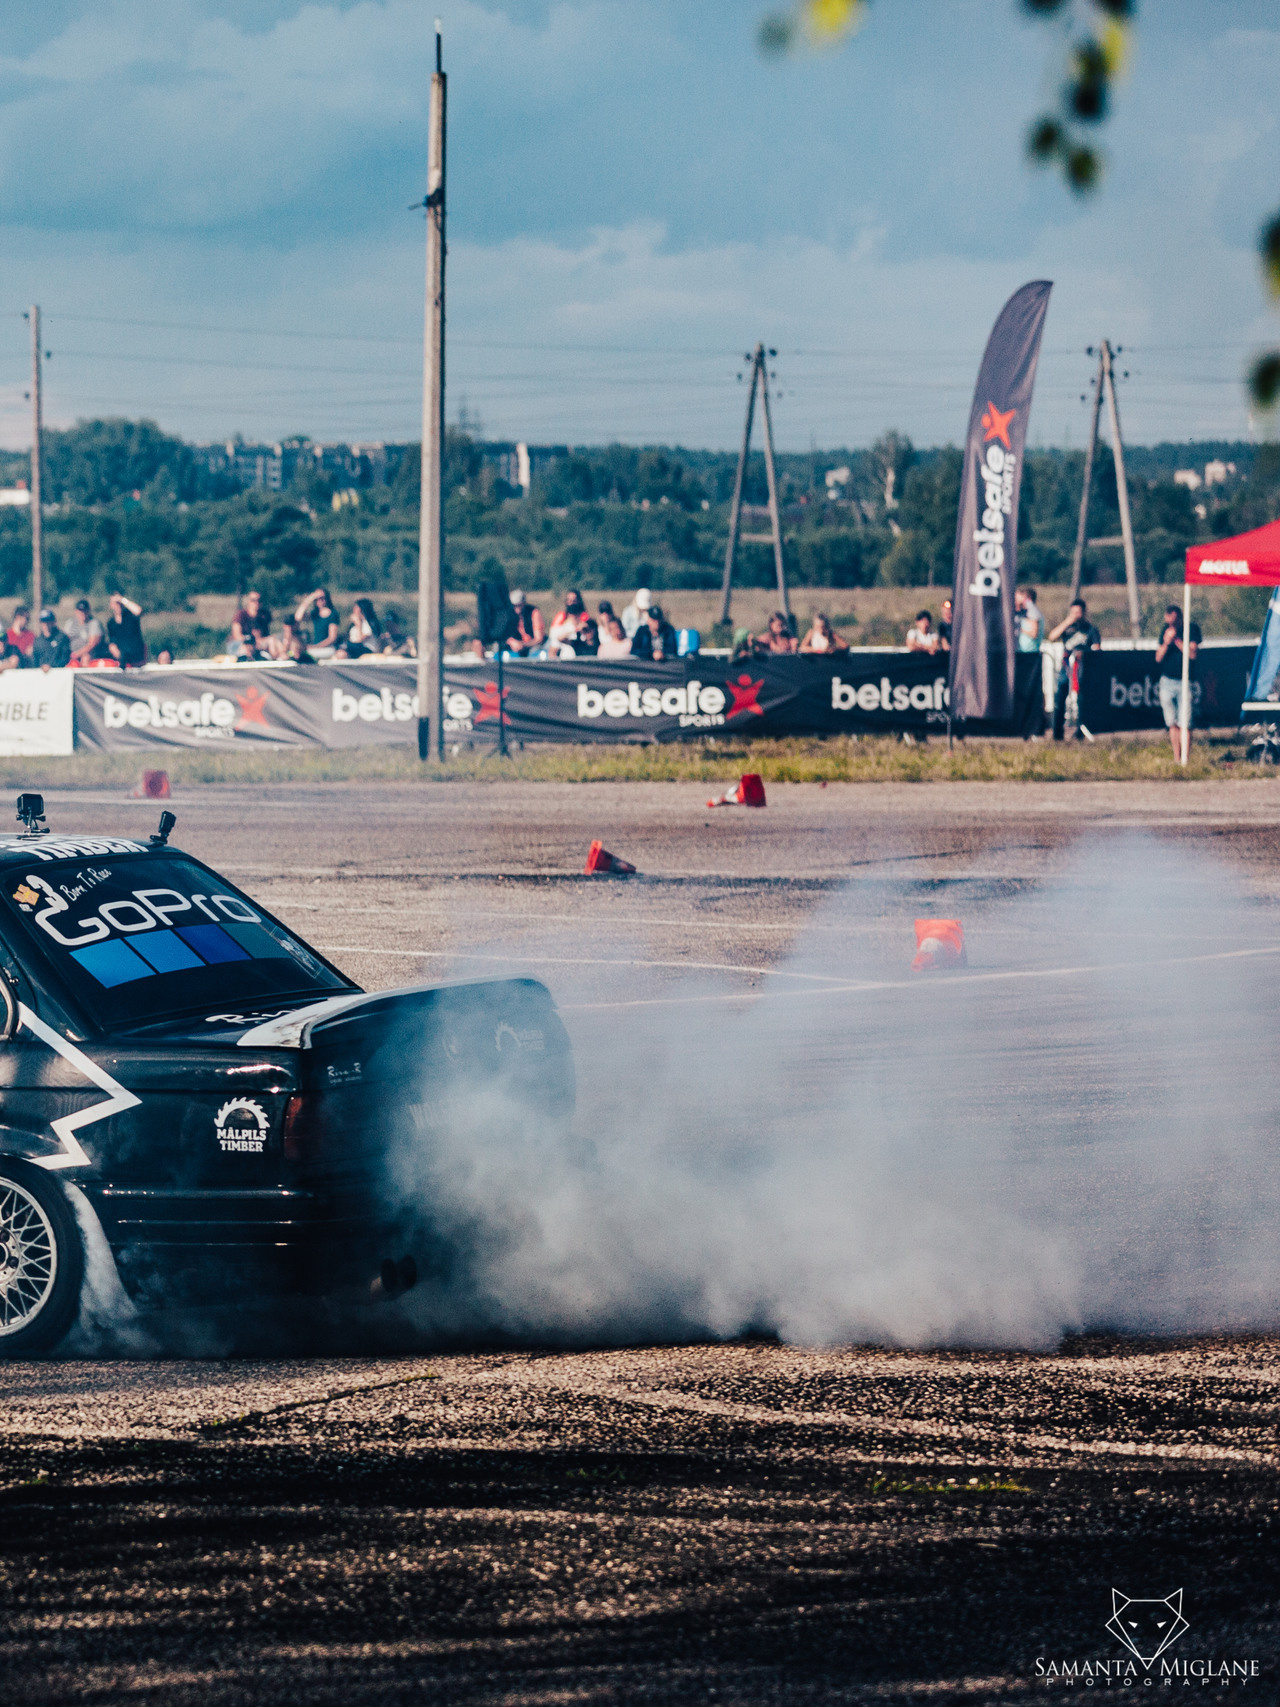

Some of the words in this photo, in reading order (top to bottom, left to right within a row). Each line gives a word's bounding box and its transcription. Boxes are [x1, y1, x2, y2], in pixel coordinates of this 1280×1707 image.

[969, 444, 1005, 597] betsafe
[1198, 559, 1251, 575] MOTUL
[103, 692, 236, 729] betsafe
[332, 685, 473, 722] betse
[577, 679, 726, 718] betsafe
[442, 719, 473, 732] ORTS
[7, 838, 150, 861] TIMBER
[34, 888, 262, 946] GoPro
[219, 1140, 264, 1153] TIMBER
